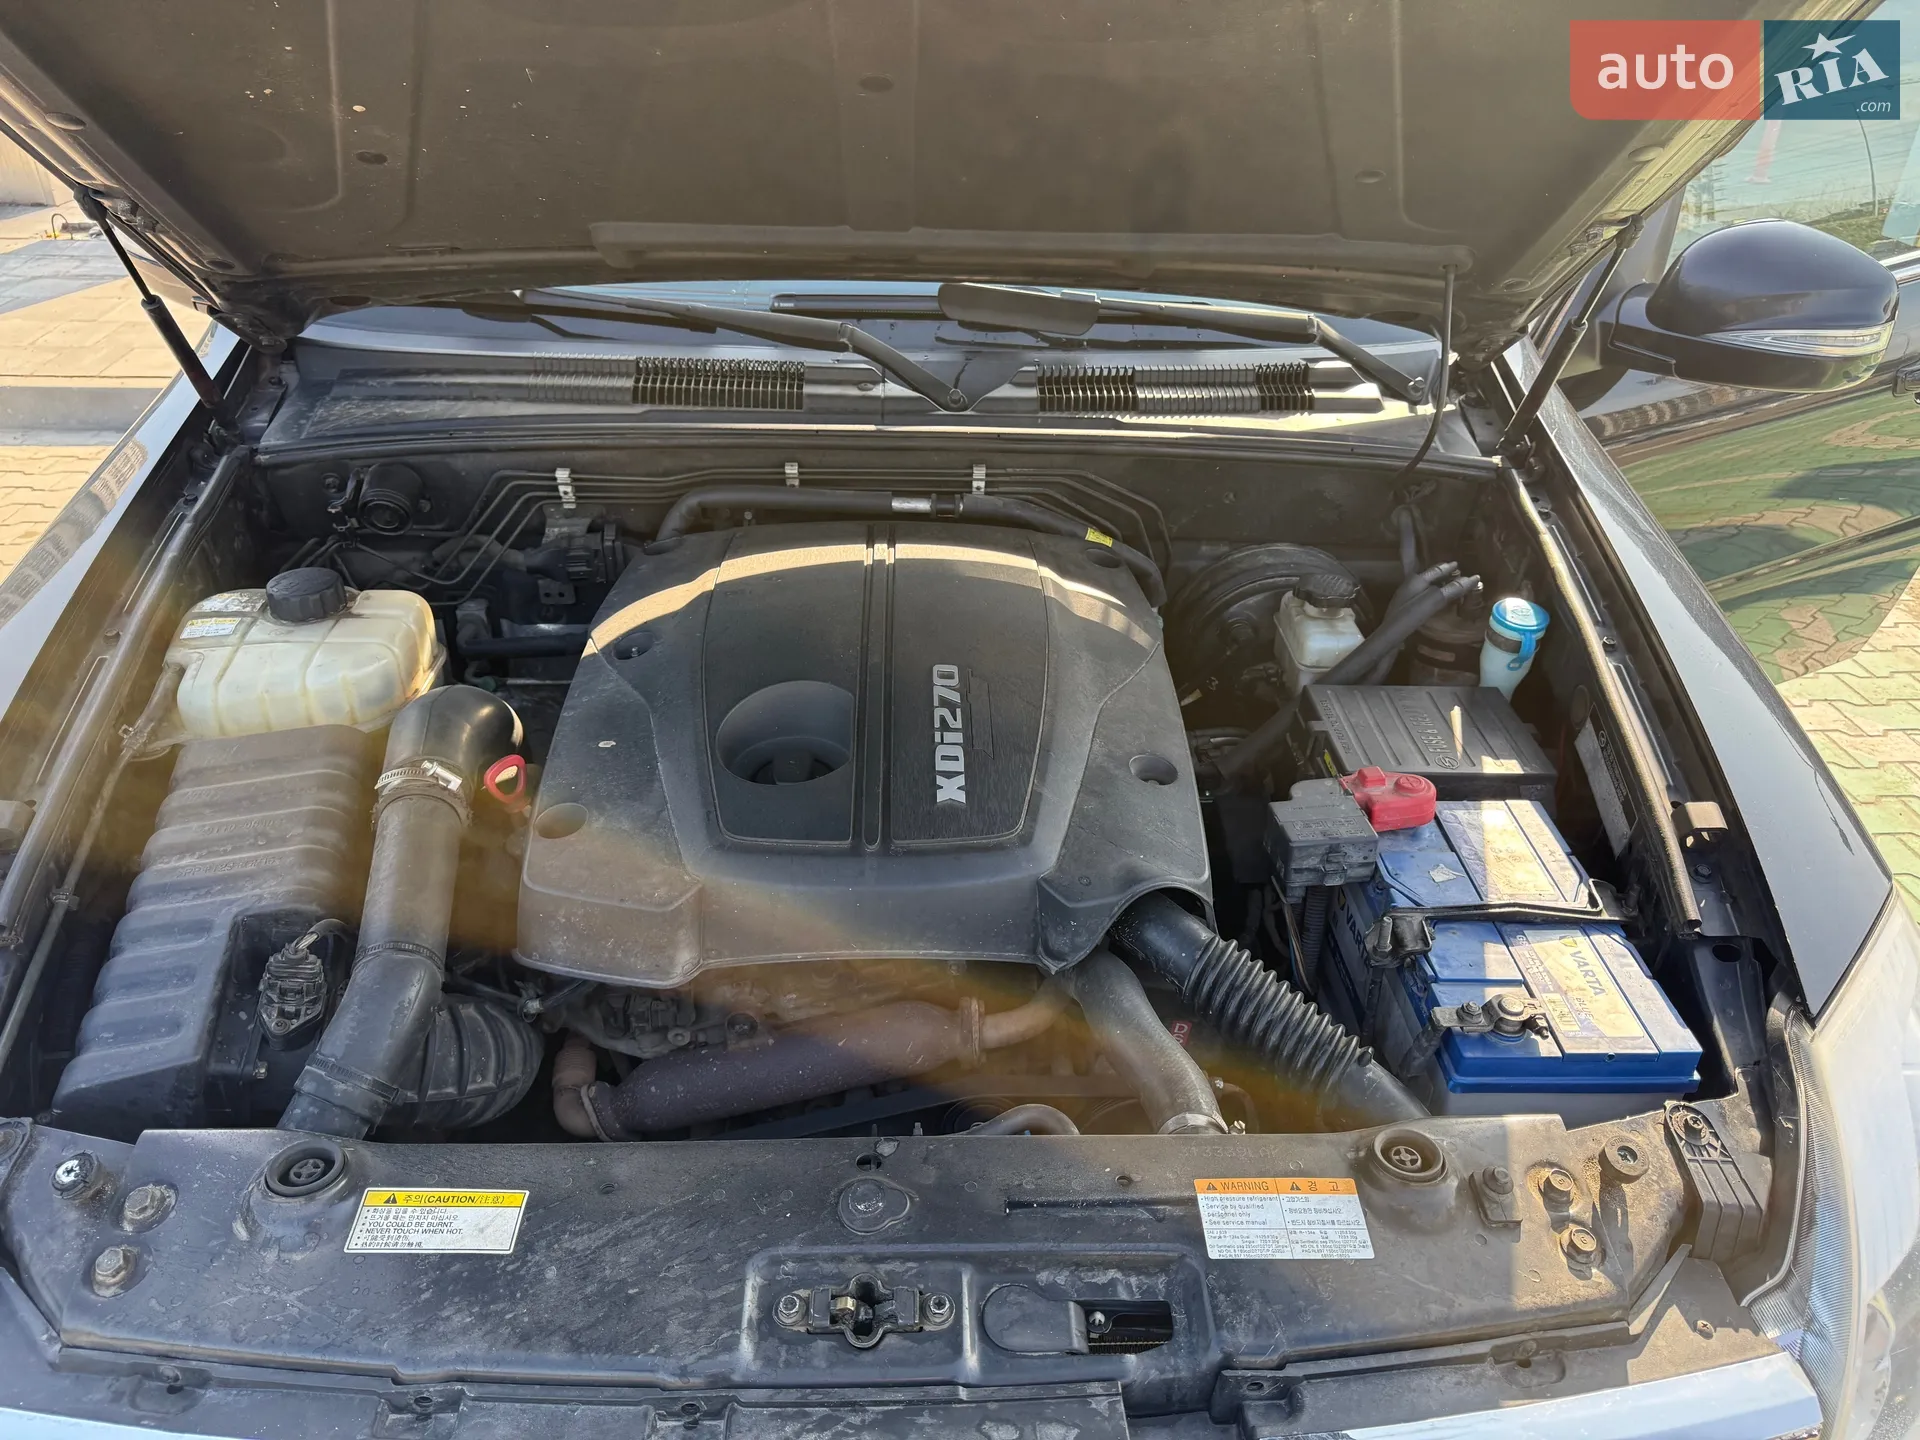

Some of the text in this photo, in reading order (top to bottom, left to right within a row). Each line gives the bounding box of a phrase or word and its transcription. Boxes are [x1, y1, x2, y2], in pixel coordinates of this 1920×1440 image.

[932, 663, 966, 804] XDi270
[1570, 950, 1606, 996] VARTA
[1220, 1181, 1269, 1191] WARNING
[1308, 1181, 1340, 1192] 경 고
